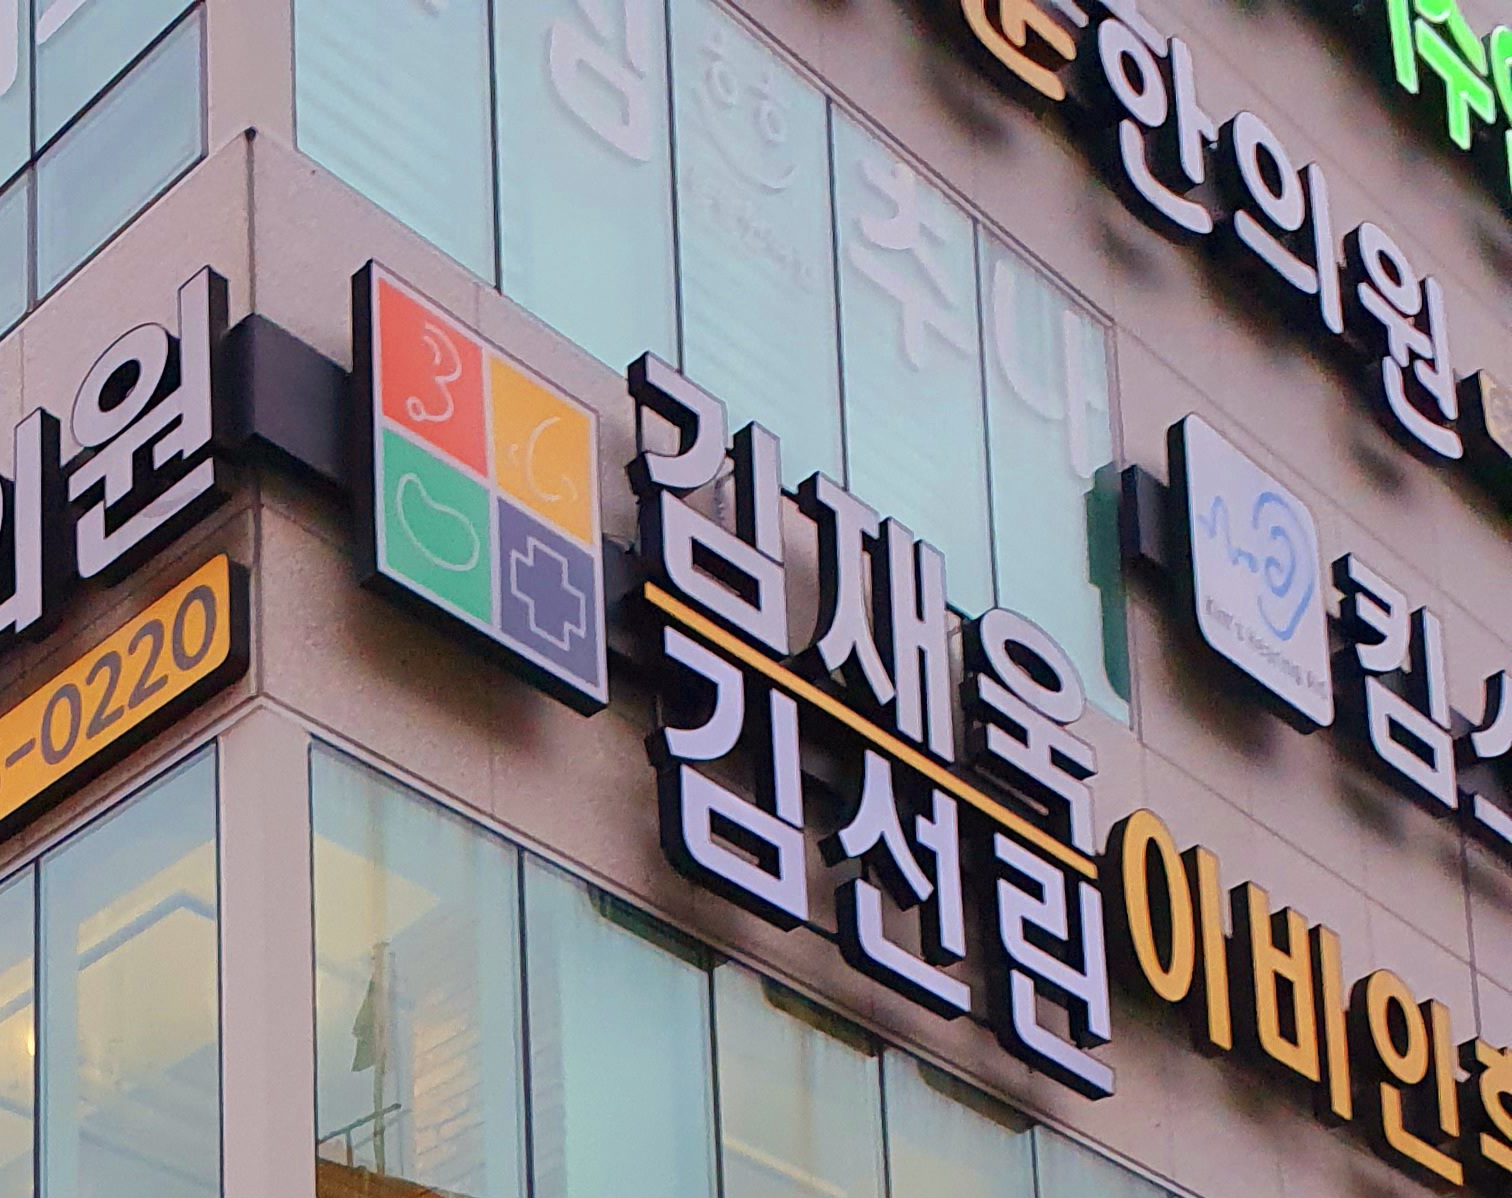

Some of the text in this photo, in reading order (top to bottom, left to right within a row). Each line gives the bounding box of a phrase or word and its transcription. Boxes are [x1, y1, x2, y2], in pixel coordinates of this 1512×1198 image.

[643, 353, 1098, 856] 김재욱
[664, 626, 1115, 1097] 김선린
[1122, 809, 1512, 1186] 이비인
